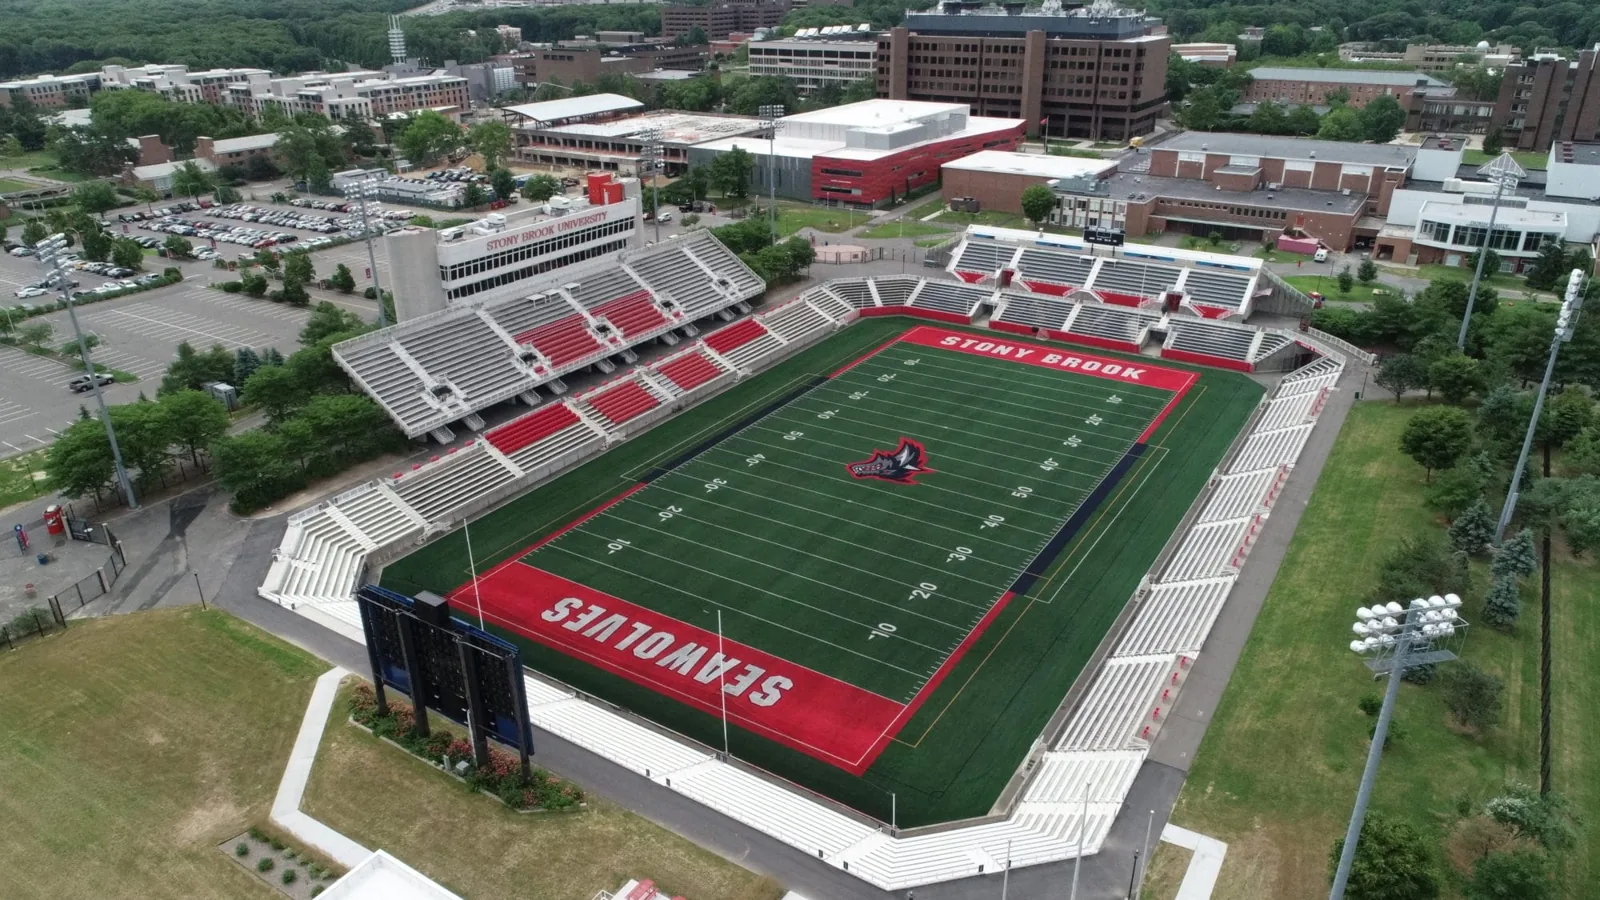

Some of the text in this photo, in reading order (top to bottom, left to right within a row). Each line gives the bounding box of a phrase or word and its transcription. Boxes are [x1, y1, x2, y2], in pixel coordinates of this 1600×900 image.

[486, 211, 608, 251] STONY BROOK UNIVERSITY
[940, 336, 1147, 379] STONY BROOK
[1085, 415, 1103, 426] 20
[783, 431, 804, 441] 50
[1063, 436, 1082, 447] 30
[746, 453, 765, 464] 40
[1040, 459, 1059, 471] 40
[704, 478, 727, 490] 30
[1011, 486, 1033, 498] 50
[658, 505, 683, 518] 20
[983, 514, 1005, 528] 40
[607, 538, 631, 551] 10
[949, 546, 973, 561] 30
[911, 582, 938, 599] 20
[871, 623, 897, 638] 10
[540, 597, 794, 708] SEAWOLVES
